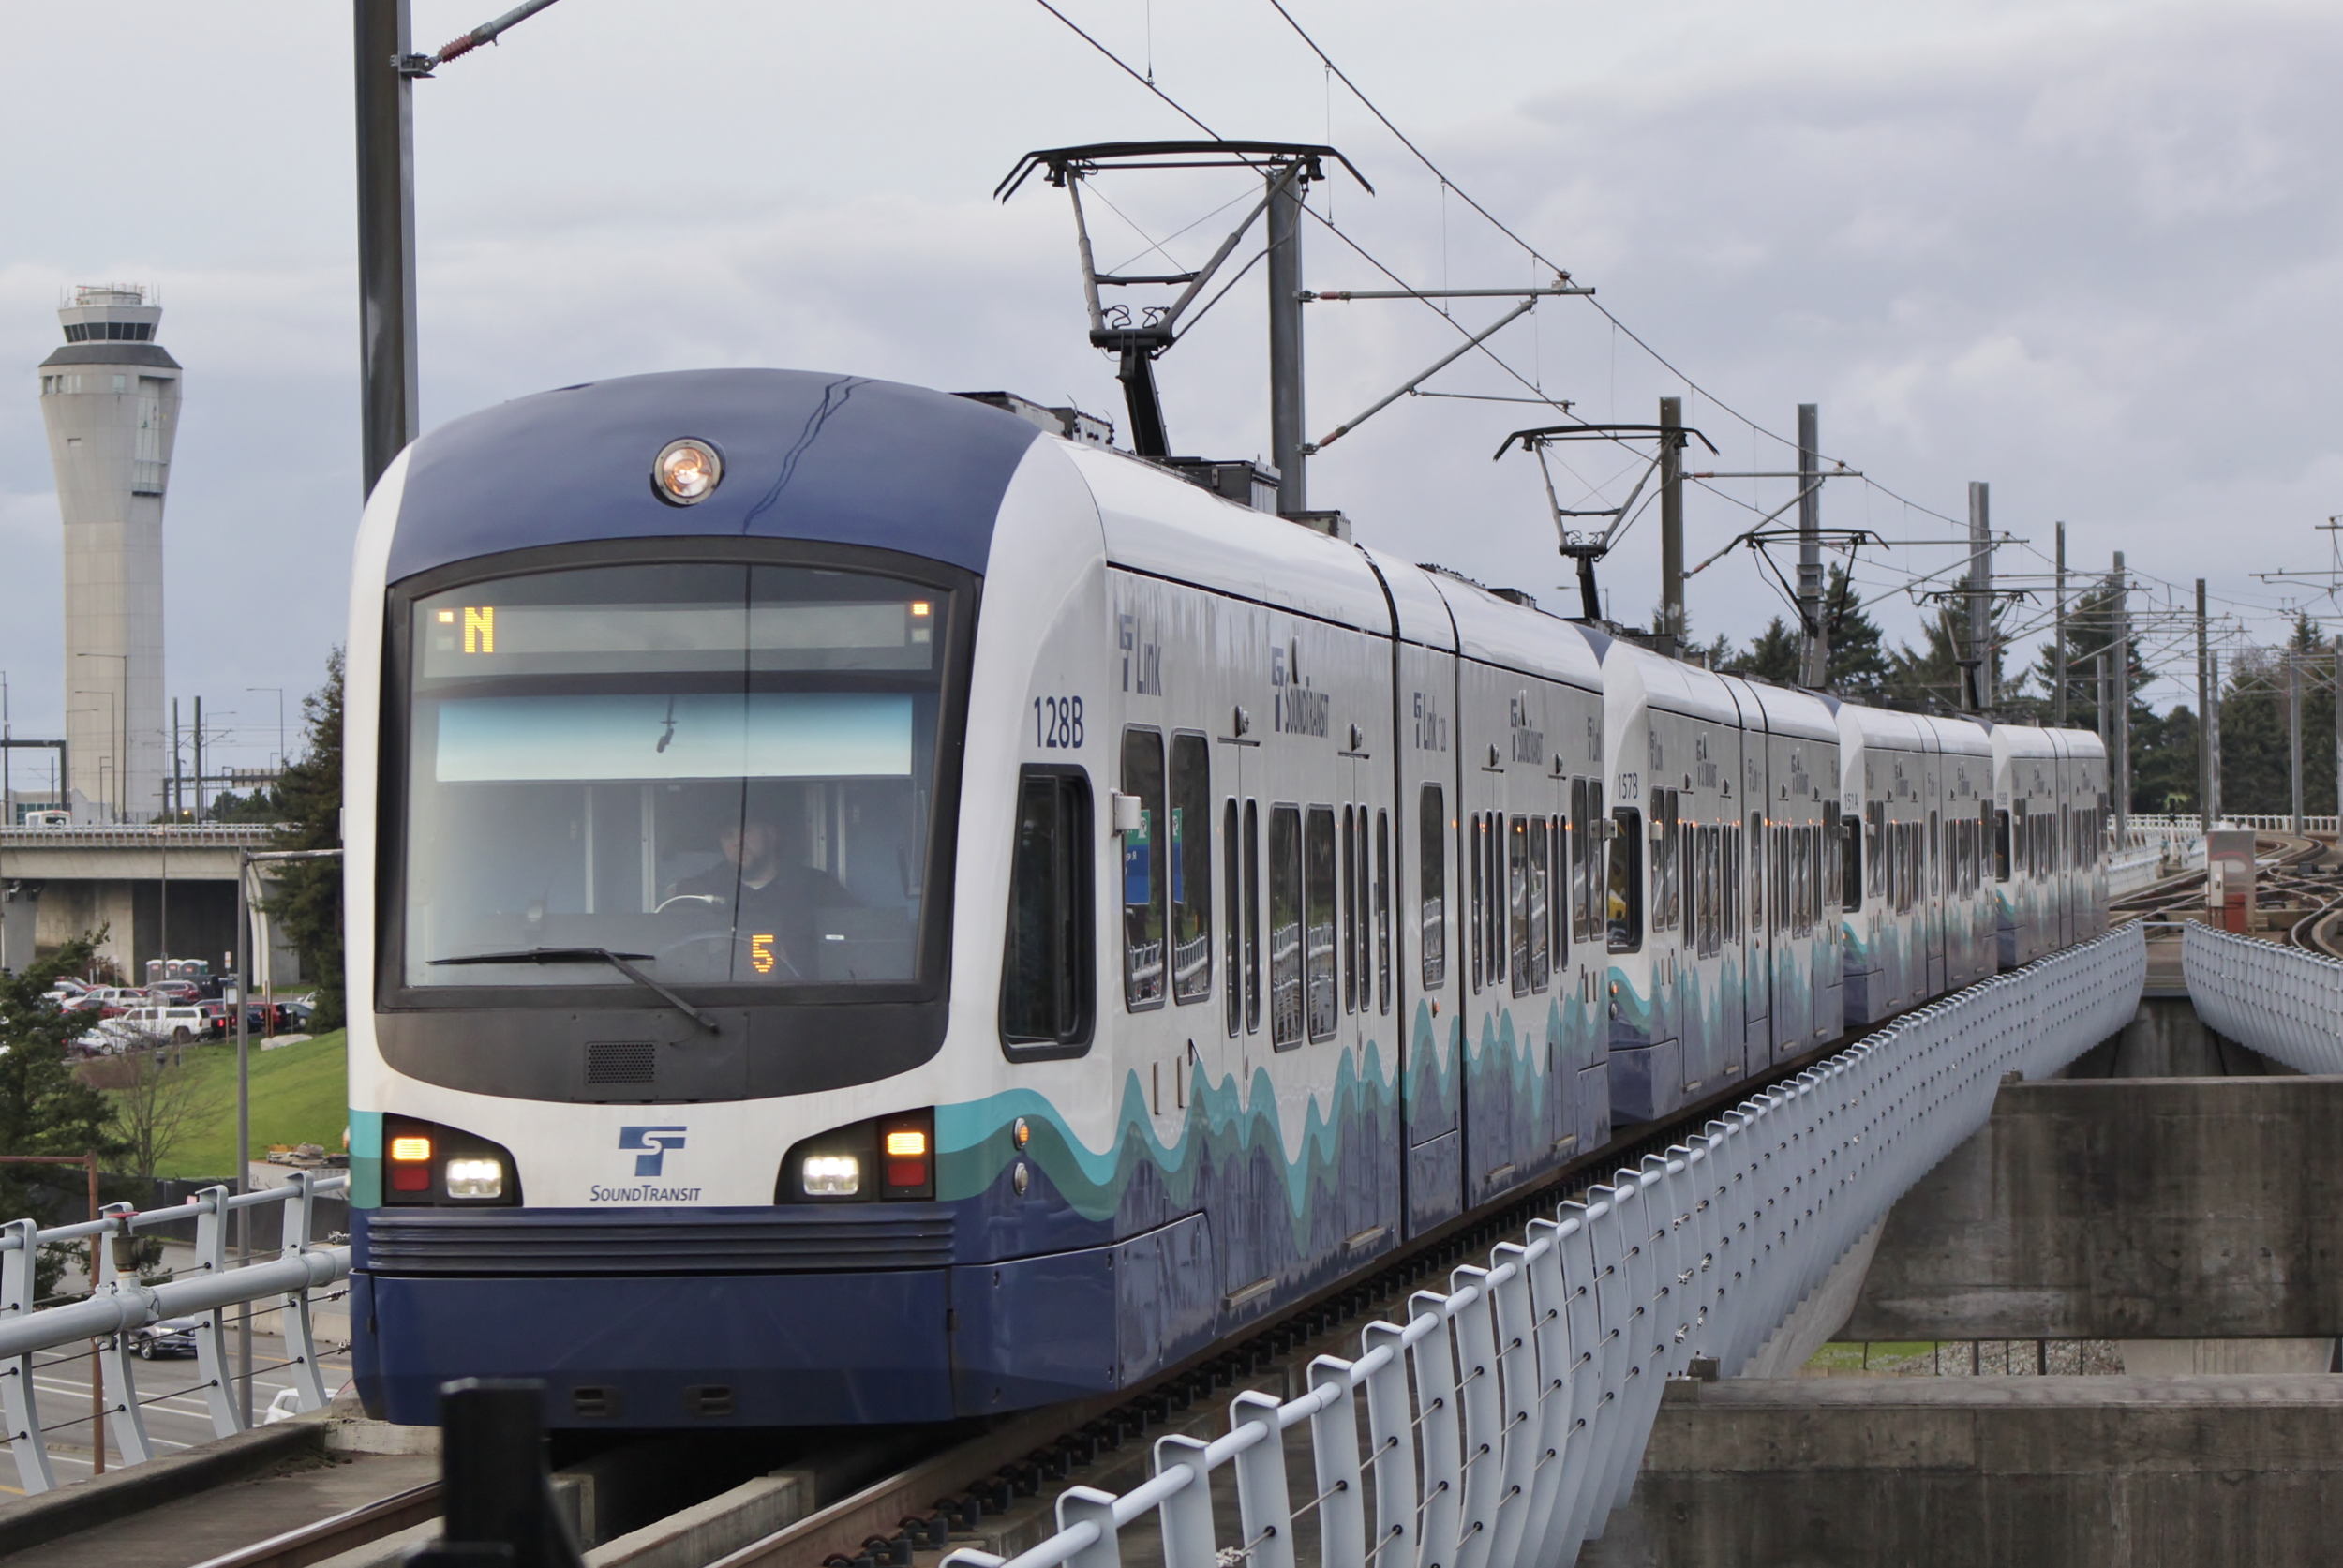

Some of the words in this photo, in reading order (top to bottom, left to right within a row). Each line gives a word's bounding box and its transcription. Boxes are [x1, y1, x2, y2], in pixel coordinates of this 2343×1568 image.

[464, 606, 494, 653] N
[1137, 617, 1162, 697] Link
[1034, 695, 1084, 749] 128B
[1618, 771, 1638, 799] 157B
[1843, 792, 1859, 811] 151A
[752, 934, 774, 973] 5
